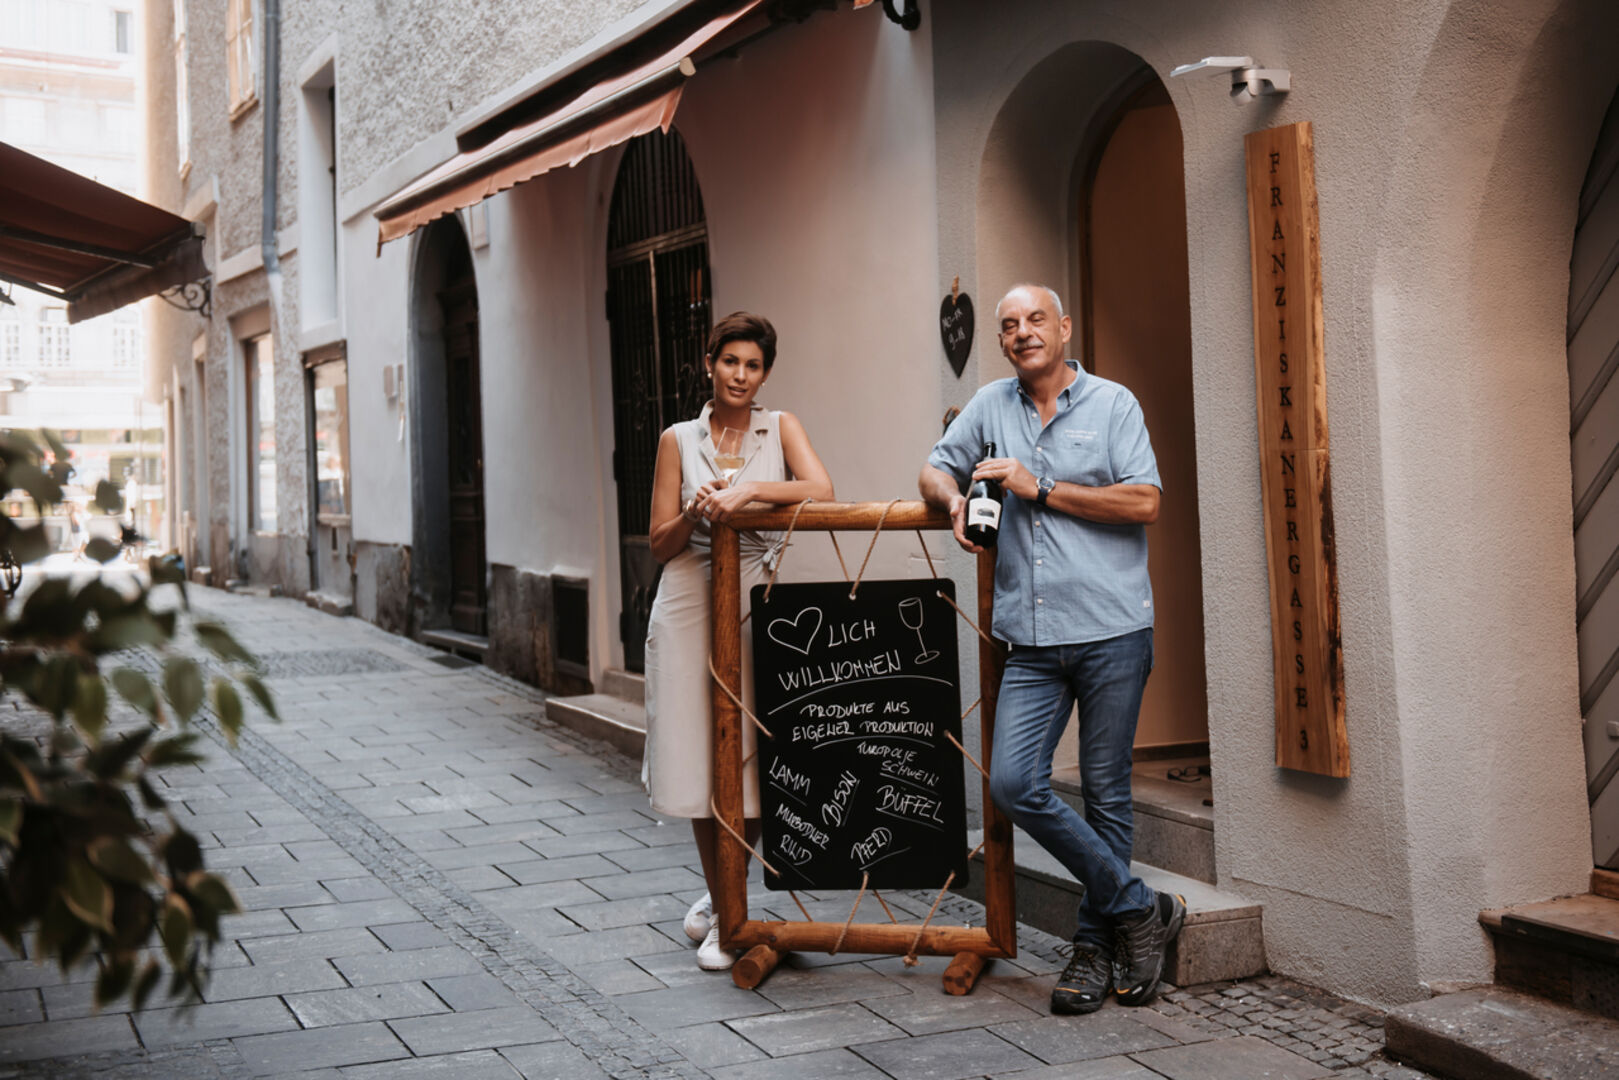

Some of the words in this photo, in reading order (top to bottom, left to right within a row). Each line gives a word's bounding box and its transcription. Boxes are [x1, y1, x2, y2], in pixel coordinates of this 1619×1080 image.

[1269, 152, 1308, 708] FRANZISKANERGASSE
[1299, 730, 1309, 751] 3
[828, 619, 876, 648] LICH
[778, 649, 902, 691] WILLKOMMEN
[800, 702, 875, 718] PRODUKTE
[883, 701, 910, 714] AUS
[792, 720, 855, 742] EIGENER
[859, 721, 934, 737] PRODUKTION
[769, 756, 811, 796] LAMM
[880, 760, 939, 787] SCHWEIN
[821, 770, 860, 827] BISON
[780, 834, 812, 866] RIND
